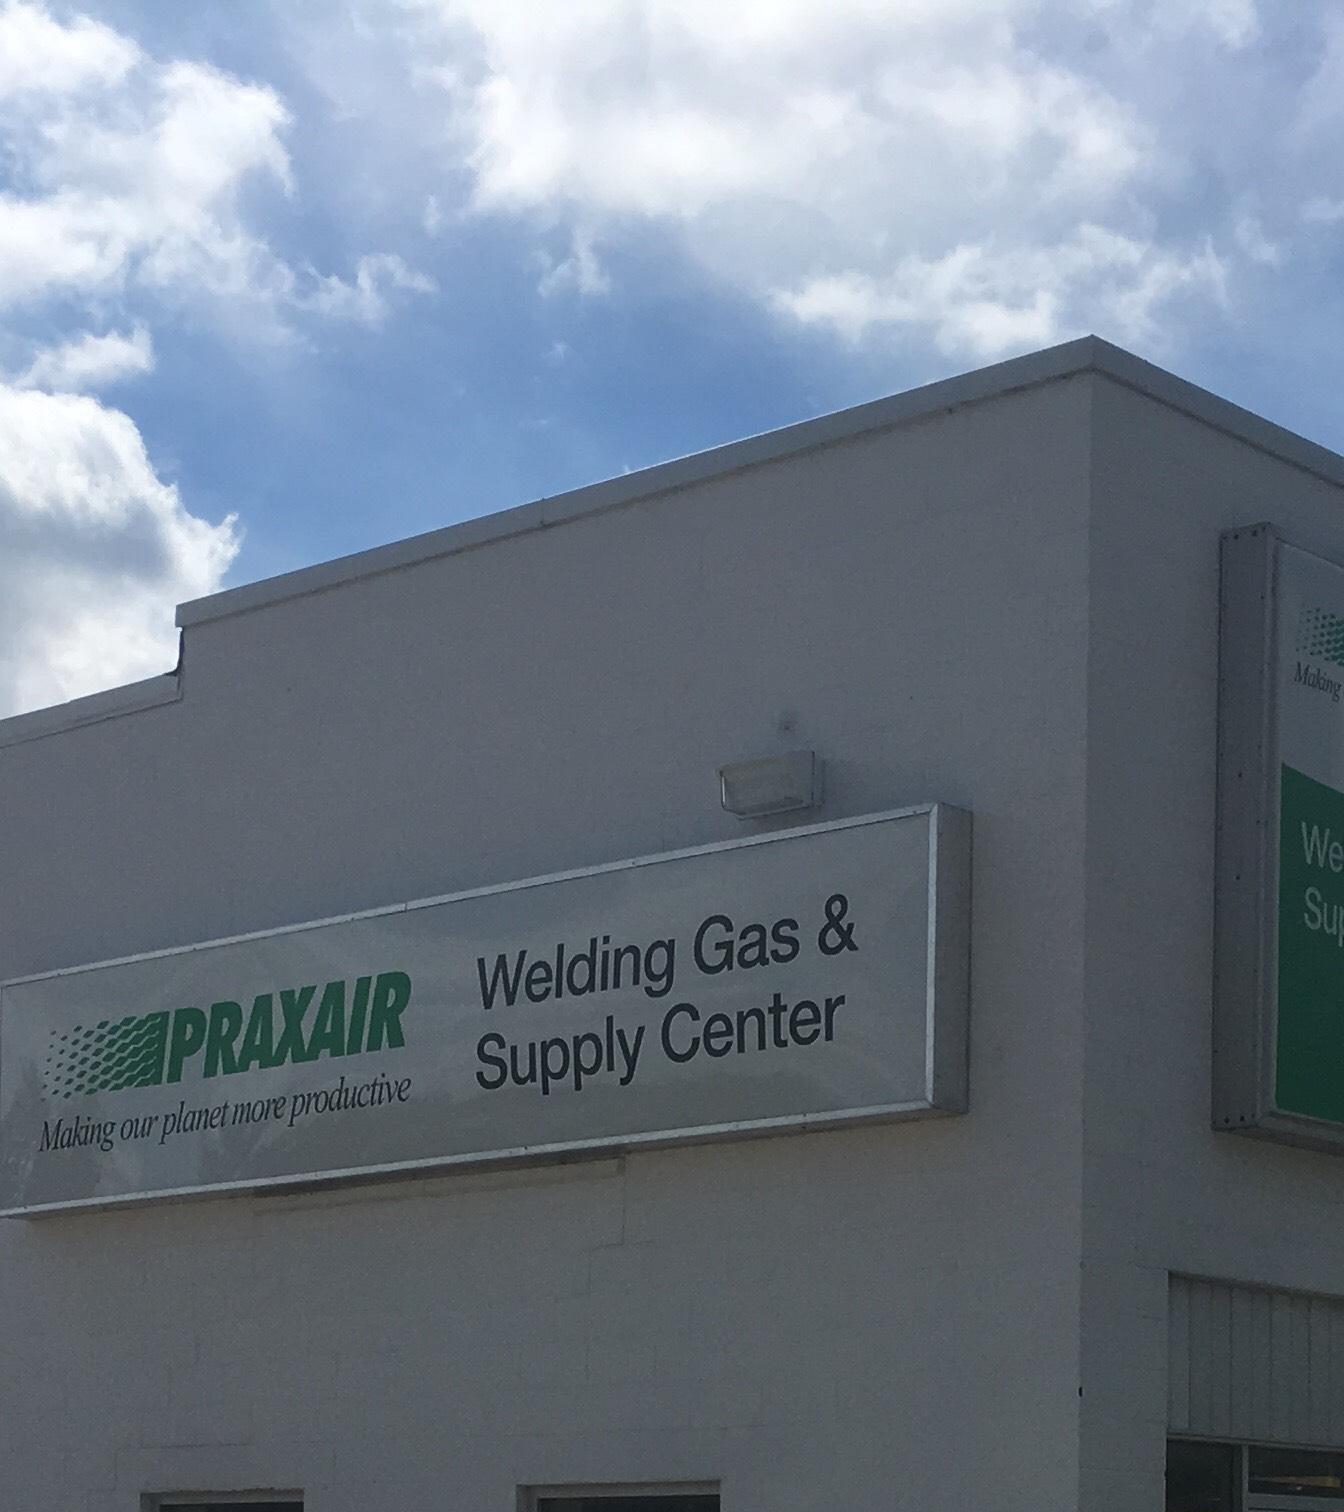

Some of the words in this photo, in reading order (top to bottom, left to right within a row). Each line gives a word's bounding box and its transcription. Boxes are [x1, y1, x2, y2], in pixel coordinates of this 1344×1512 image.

[1294, 661, 1341, 703] Making
[477, 935, 676, 1010] Welding
[693, 914, 800, 975] Gas
[817, 893, 858, 955] &
[167, 971, 412, 1085] PRAXAIR
[475, 1015, 646, 1096] Supply
[661, 993, 846, 1063] Center
[39, 1117, 116, 1152] Making
[120, 1114, 159, 1140] our
[159, 1102, 230, 1145] planet
[232, 1094, 286, 1125] more
[289, 1072, 412, 1127] productive
